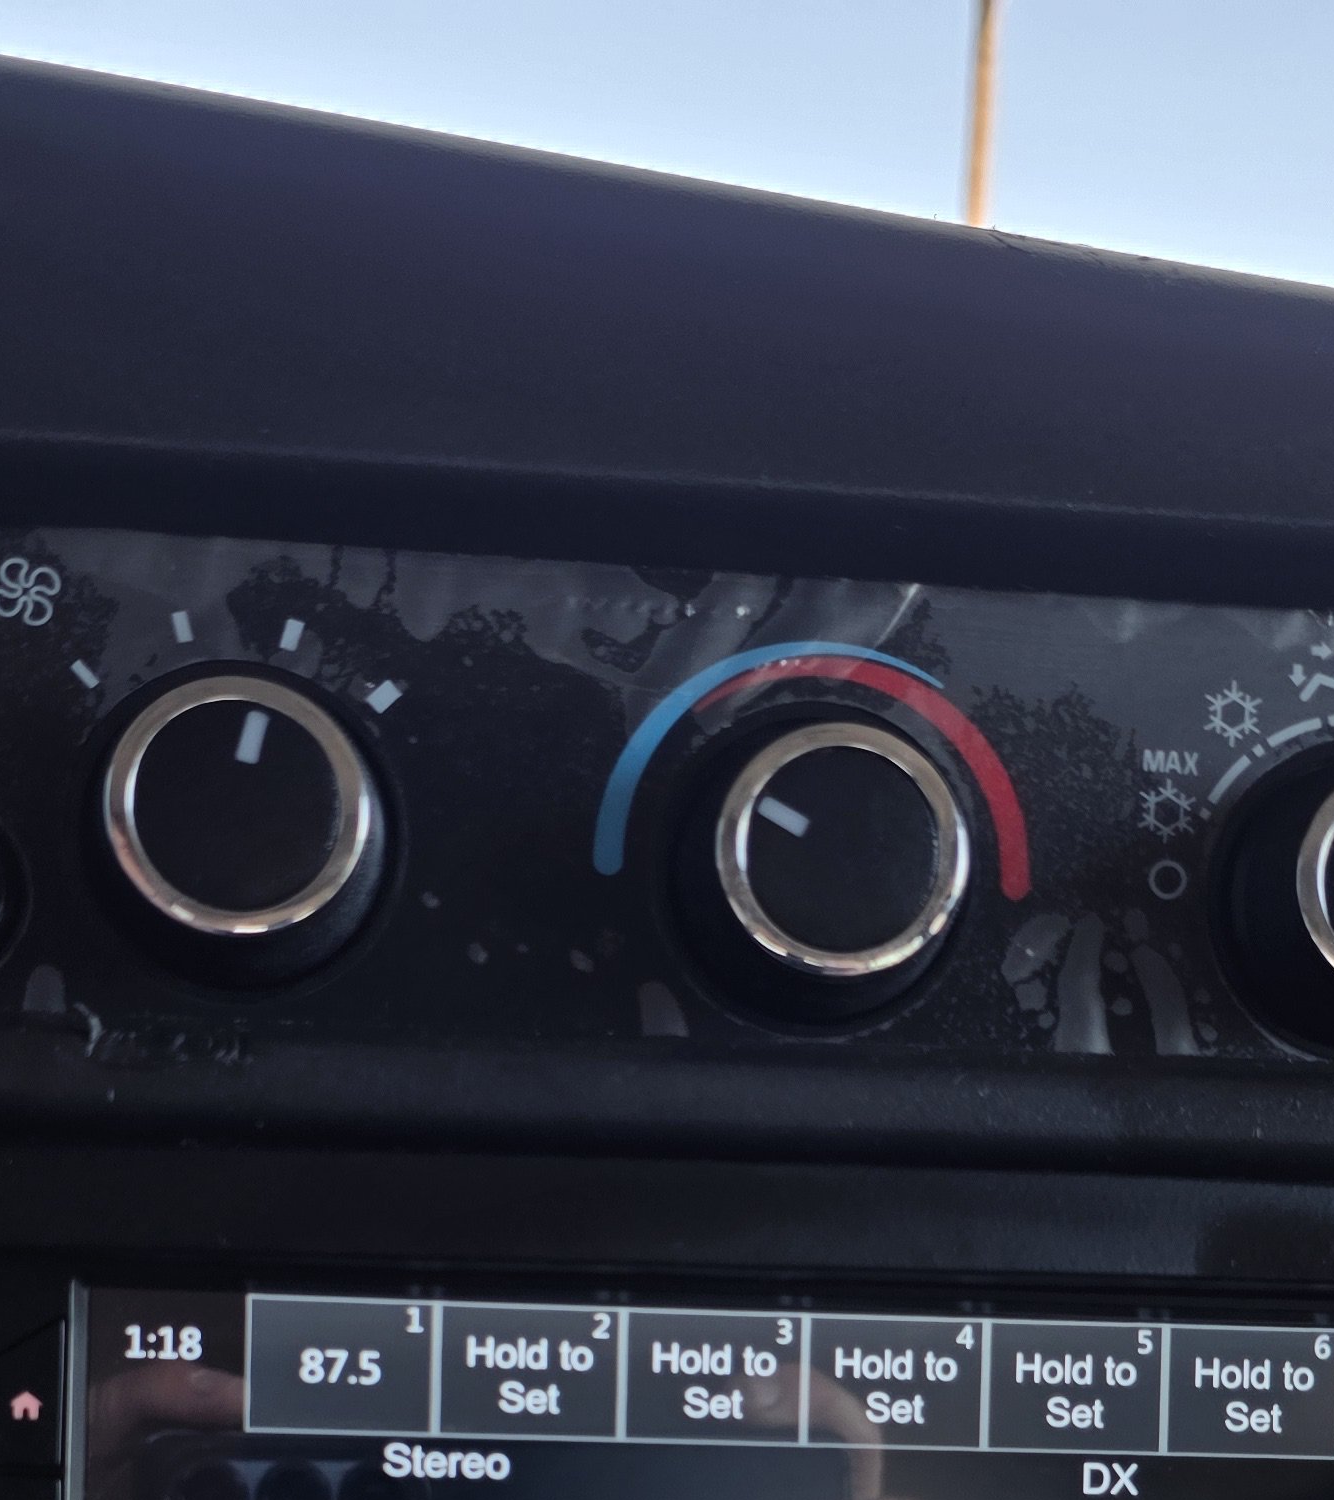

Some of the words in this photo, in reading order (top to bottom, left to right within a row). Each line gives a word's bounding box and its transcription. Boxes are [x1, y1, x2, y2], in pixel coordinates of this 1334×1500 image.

[1142, 749, 1199, 777] MAX
[405, 1307, 425, 1334] 1
[591, 1313, 611, 1340] 2
[775, 1319, 794, 1345] 3
[955, 1324, 975, 1350] 4
[124, 1325, 204, 1361] 1:18
[466, 1336, 550, 1371] Hold
[559, 1338, 595, 1372] to
[652, 1342, 733, 1376] Hold
[743, 1344, 778, 1377] to
[1136, 1330, 1154, 1355] 5
[1313, 1334, 1332, 1360] 6
[299, 1349, 382, 1386] 87.5
[834, 1347, 914, 1381] Hold
[924, 1349, 958, 1382] to
[1015, 1353, 1094, 1386] Hold
[1103, 1355, 1137, 1387] to
[1193, 1358, 1272, 1390] Hold
[1282, 1360, 1315, 1392] to
[498, 1381, 561, 1416] Set
[683, 1386, 744, 1420] Set
[865, 1391, 925, 1425] Set
[1046, 1397, 1105, 1430] Set
[1224, 1402, 1283, 1434] Set
[382, 1442, 511, 1481] Stereo
[1082, 1462, 1140, 1496] DX
